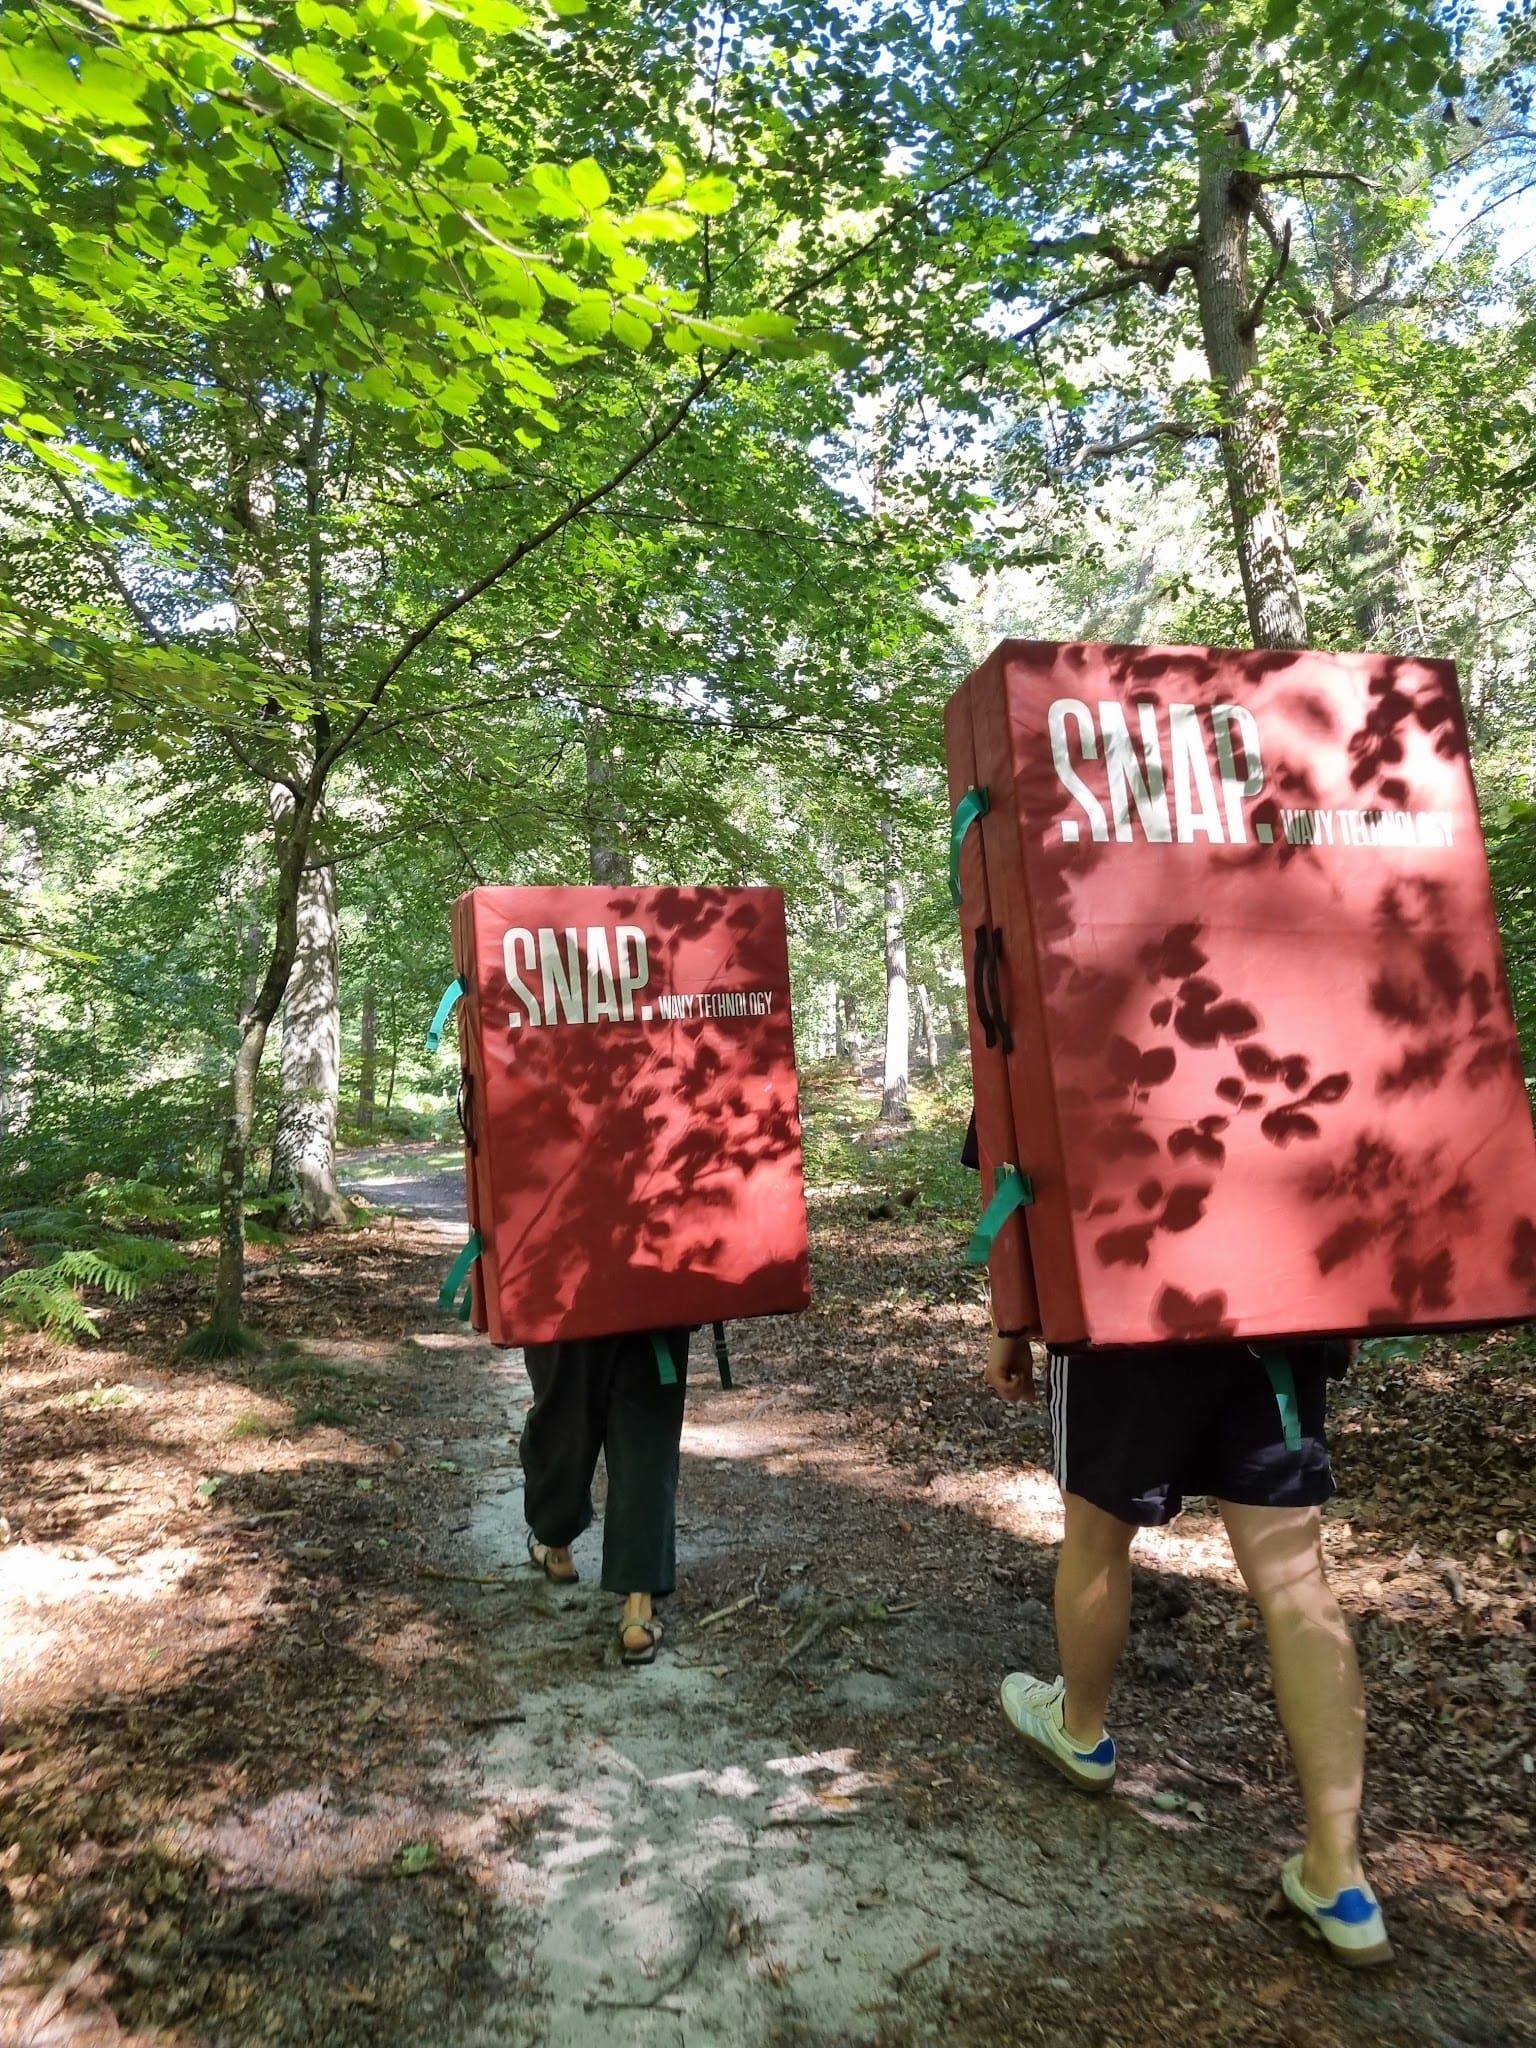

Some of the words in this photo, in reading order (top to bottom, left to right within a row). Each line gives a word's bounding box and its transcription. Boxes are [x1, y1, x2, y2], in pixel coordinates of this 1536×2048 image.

[1280, 808, 1335, 846] WAVY
[1336, 809, 1454, 847] TECHNOLOY
[658, 994, 694, 1020] WAVY
[696, 991, 773, 1018] TECHNOLOGY
